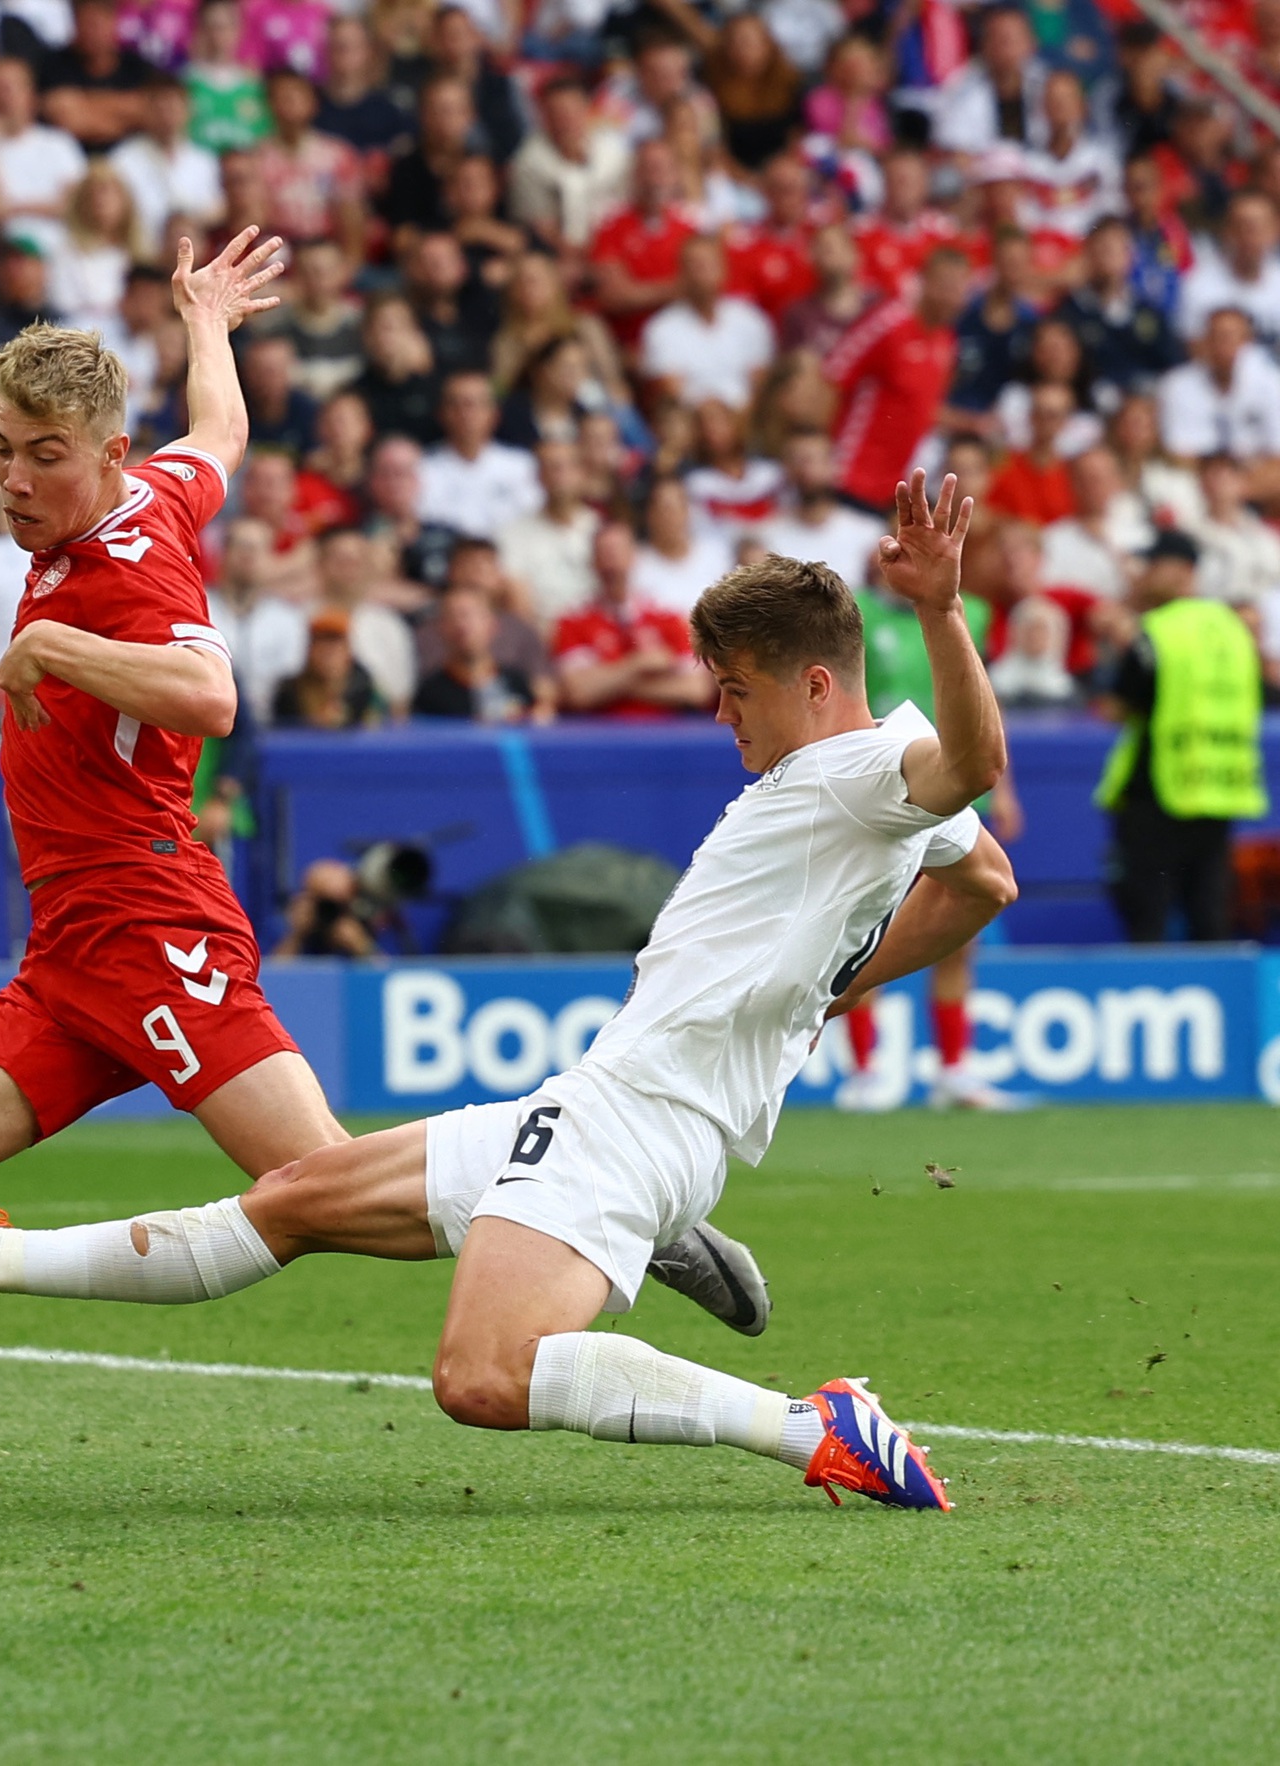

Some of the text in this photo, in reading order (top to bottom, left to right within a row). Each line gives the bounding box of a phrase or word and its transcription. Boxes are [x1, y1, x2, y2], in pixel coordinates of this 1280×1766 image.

[141, 1004, 202, 1085] 9
[383, 968, 1225, 1112] Boog.com
[508, 1106, 562, 1166] 6
